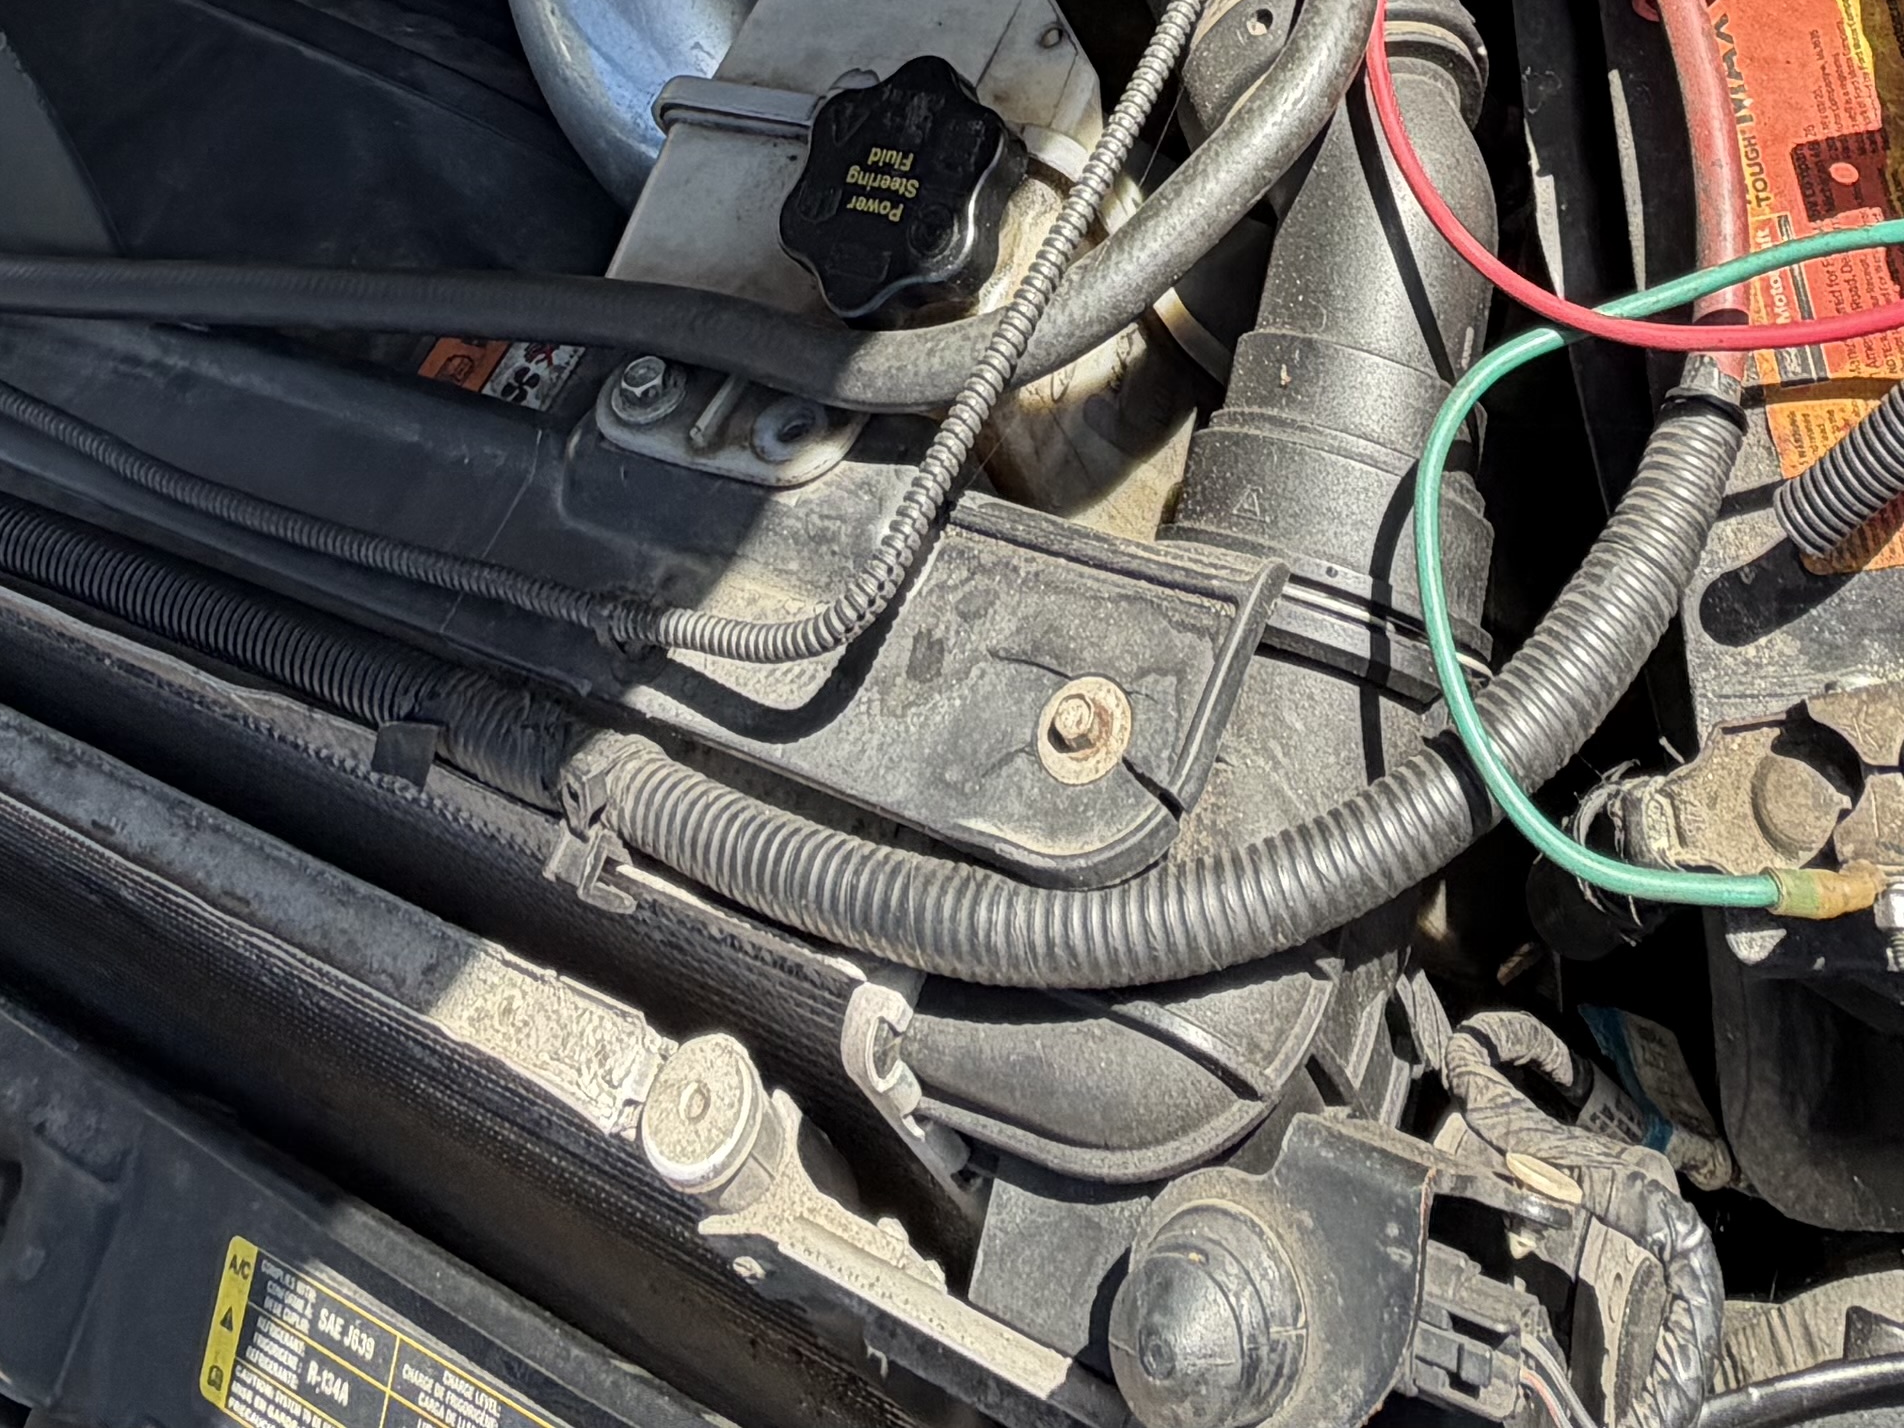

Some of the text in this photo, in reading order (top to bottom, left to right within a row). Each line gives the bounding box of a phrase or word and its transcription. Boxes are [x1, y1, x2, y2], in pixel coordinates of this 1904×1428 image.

[867, 147, 914, 172] Fluid
[846, 165, 919, 199] Steering
[846, 195, 904, 223] Power
[228, 1253, 252, 1281] A/C
[318, 1308, 375, 1362] SAE J639
[306, 1360, 350, 1407] R-134A
